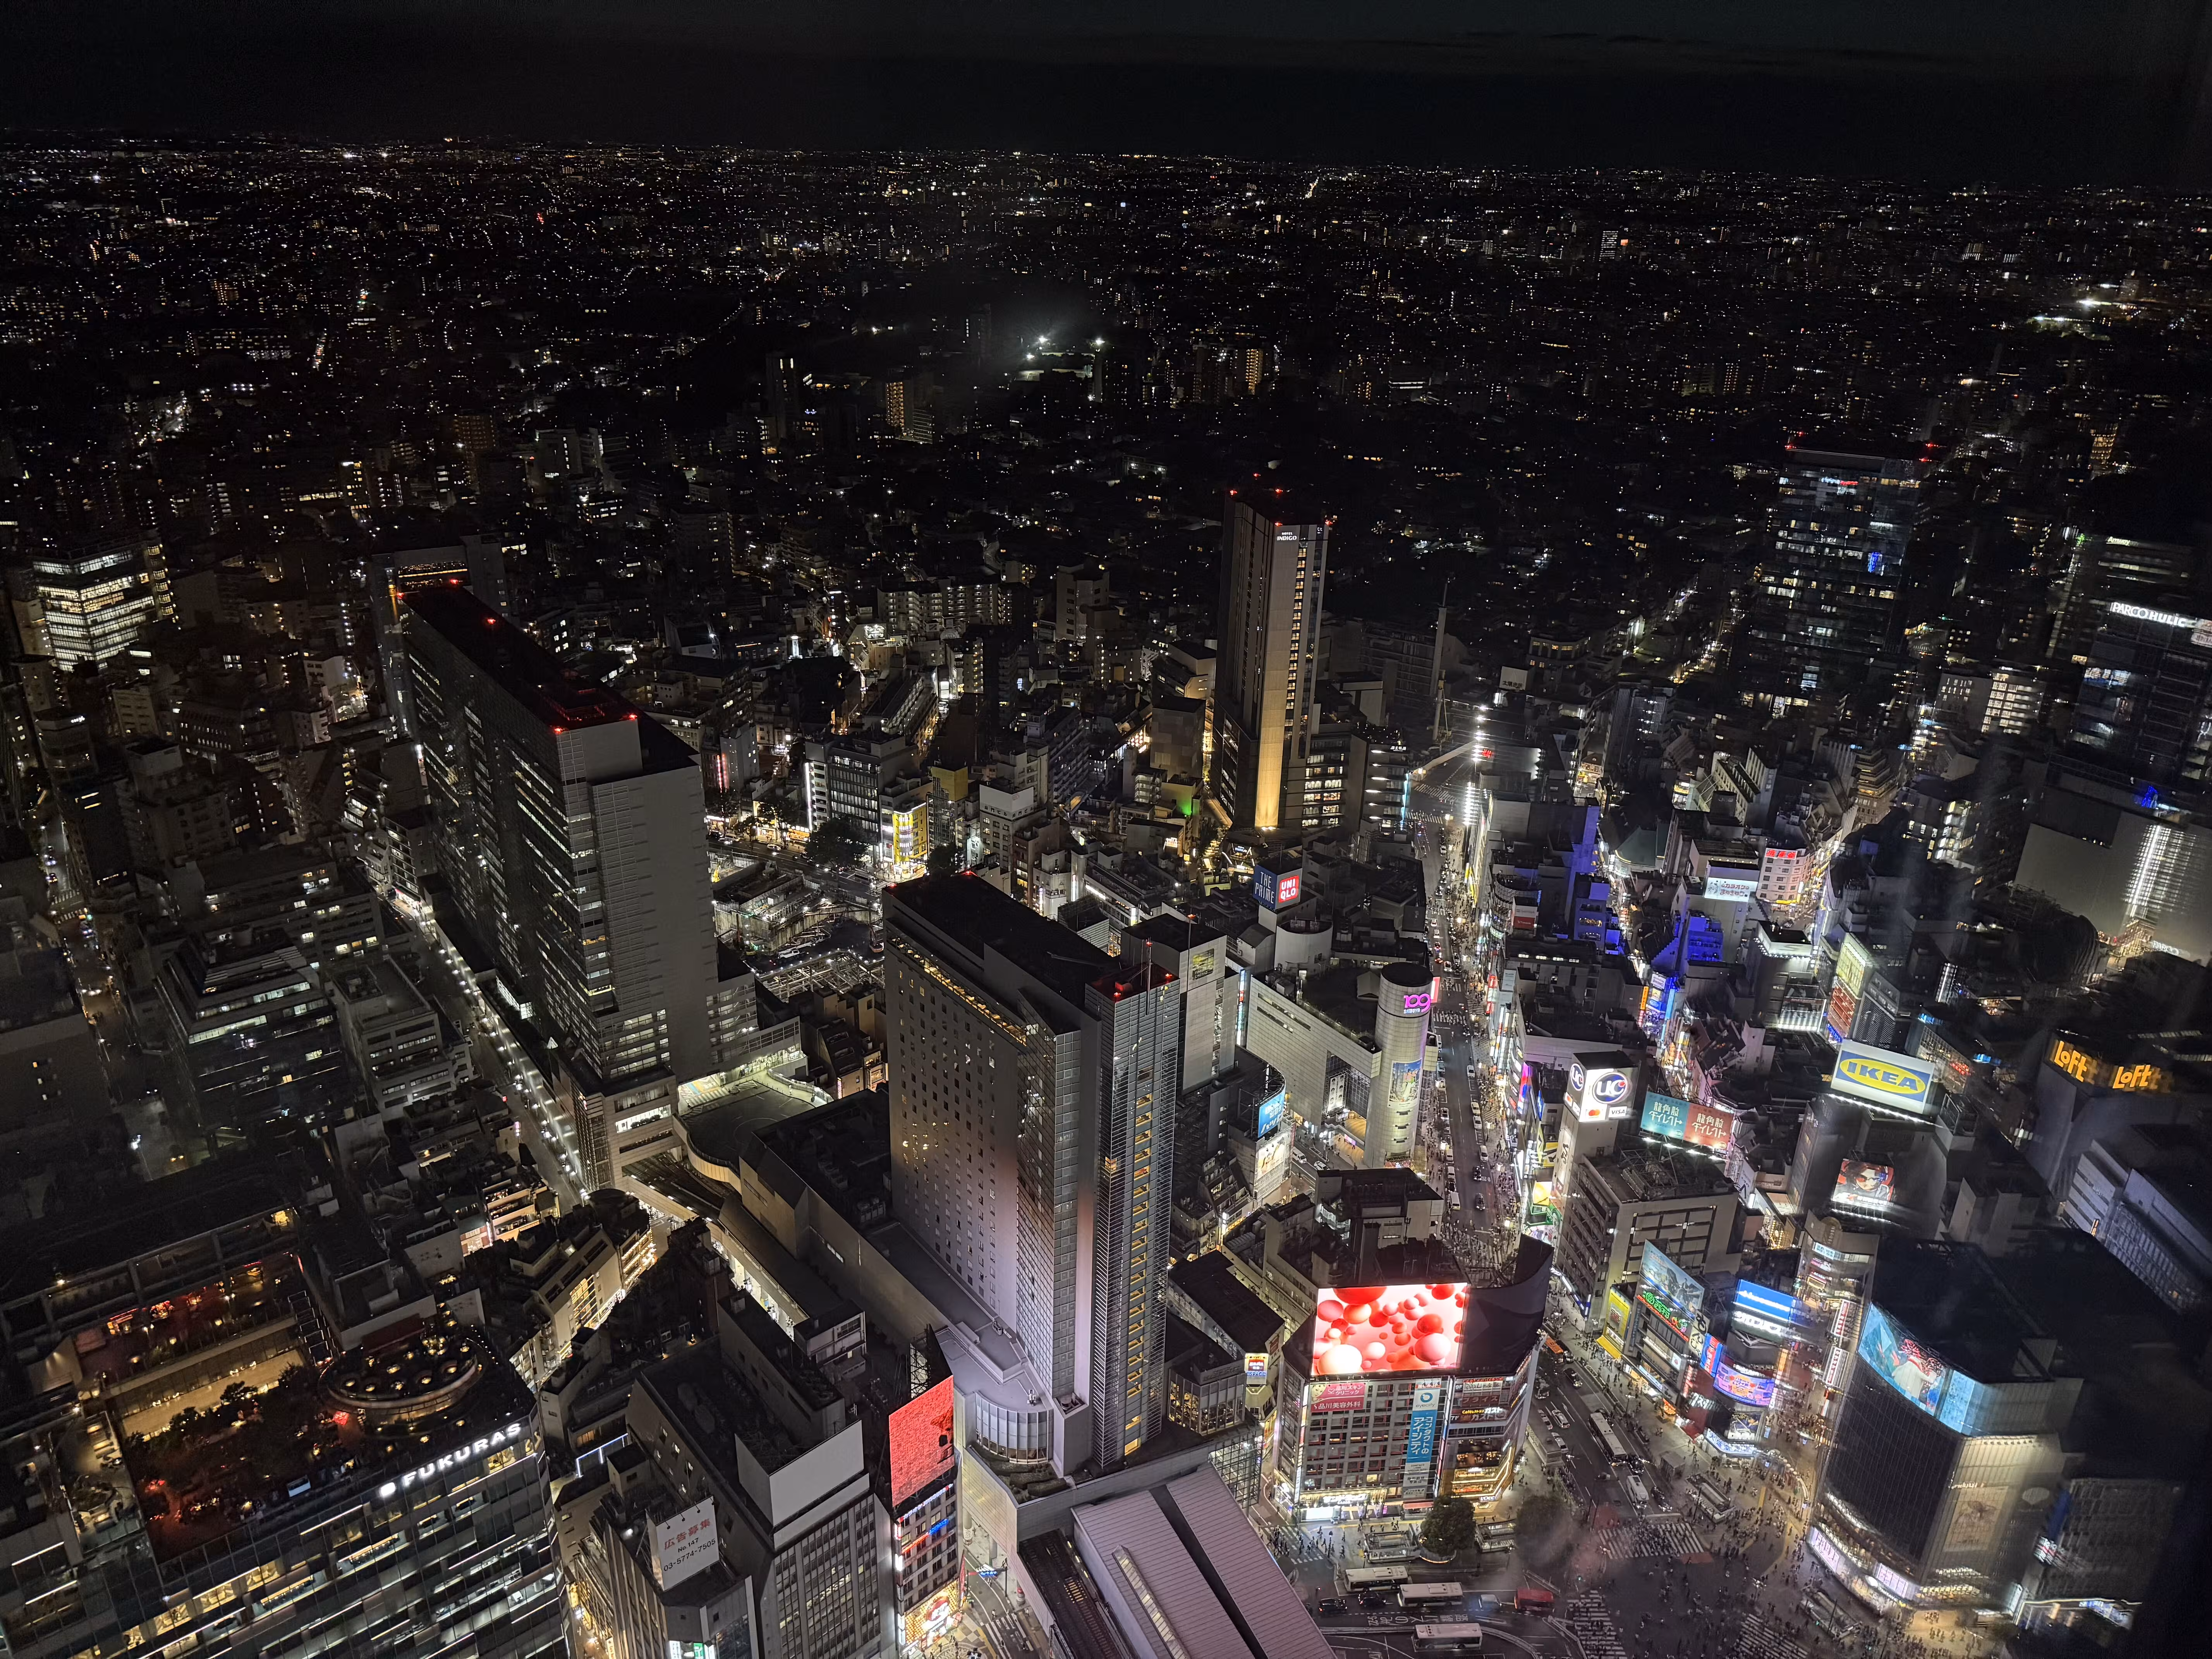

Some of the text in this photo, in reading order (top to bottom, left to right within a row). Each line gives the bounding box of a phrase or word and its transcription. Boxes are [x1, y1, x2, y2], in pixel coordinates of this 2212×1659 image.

[2107, 536, 2130, 546] Amway
[2112, 602, 2149, 618] PARCO
[1261, 872, 1271, 889] THE
[1281, 878, 1296, 890] UNI
[1255, 882, 1274, 904] PRIME
[1281, 888, 1296, 900] QLO
[1404, 993, 1431, 1013] 109
[1847, 1061, 1918, 1091] IKEA
[1596, 1079, 1625, 1097] UC
[1411, 1417, 1422, 1455] アイシティ
[403, 1422, 521, 1485] FUKURAS
[663, 1538, 716, 1571] 03-5774-7505
